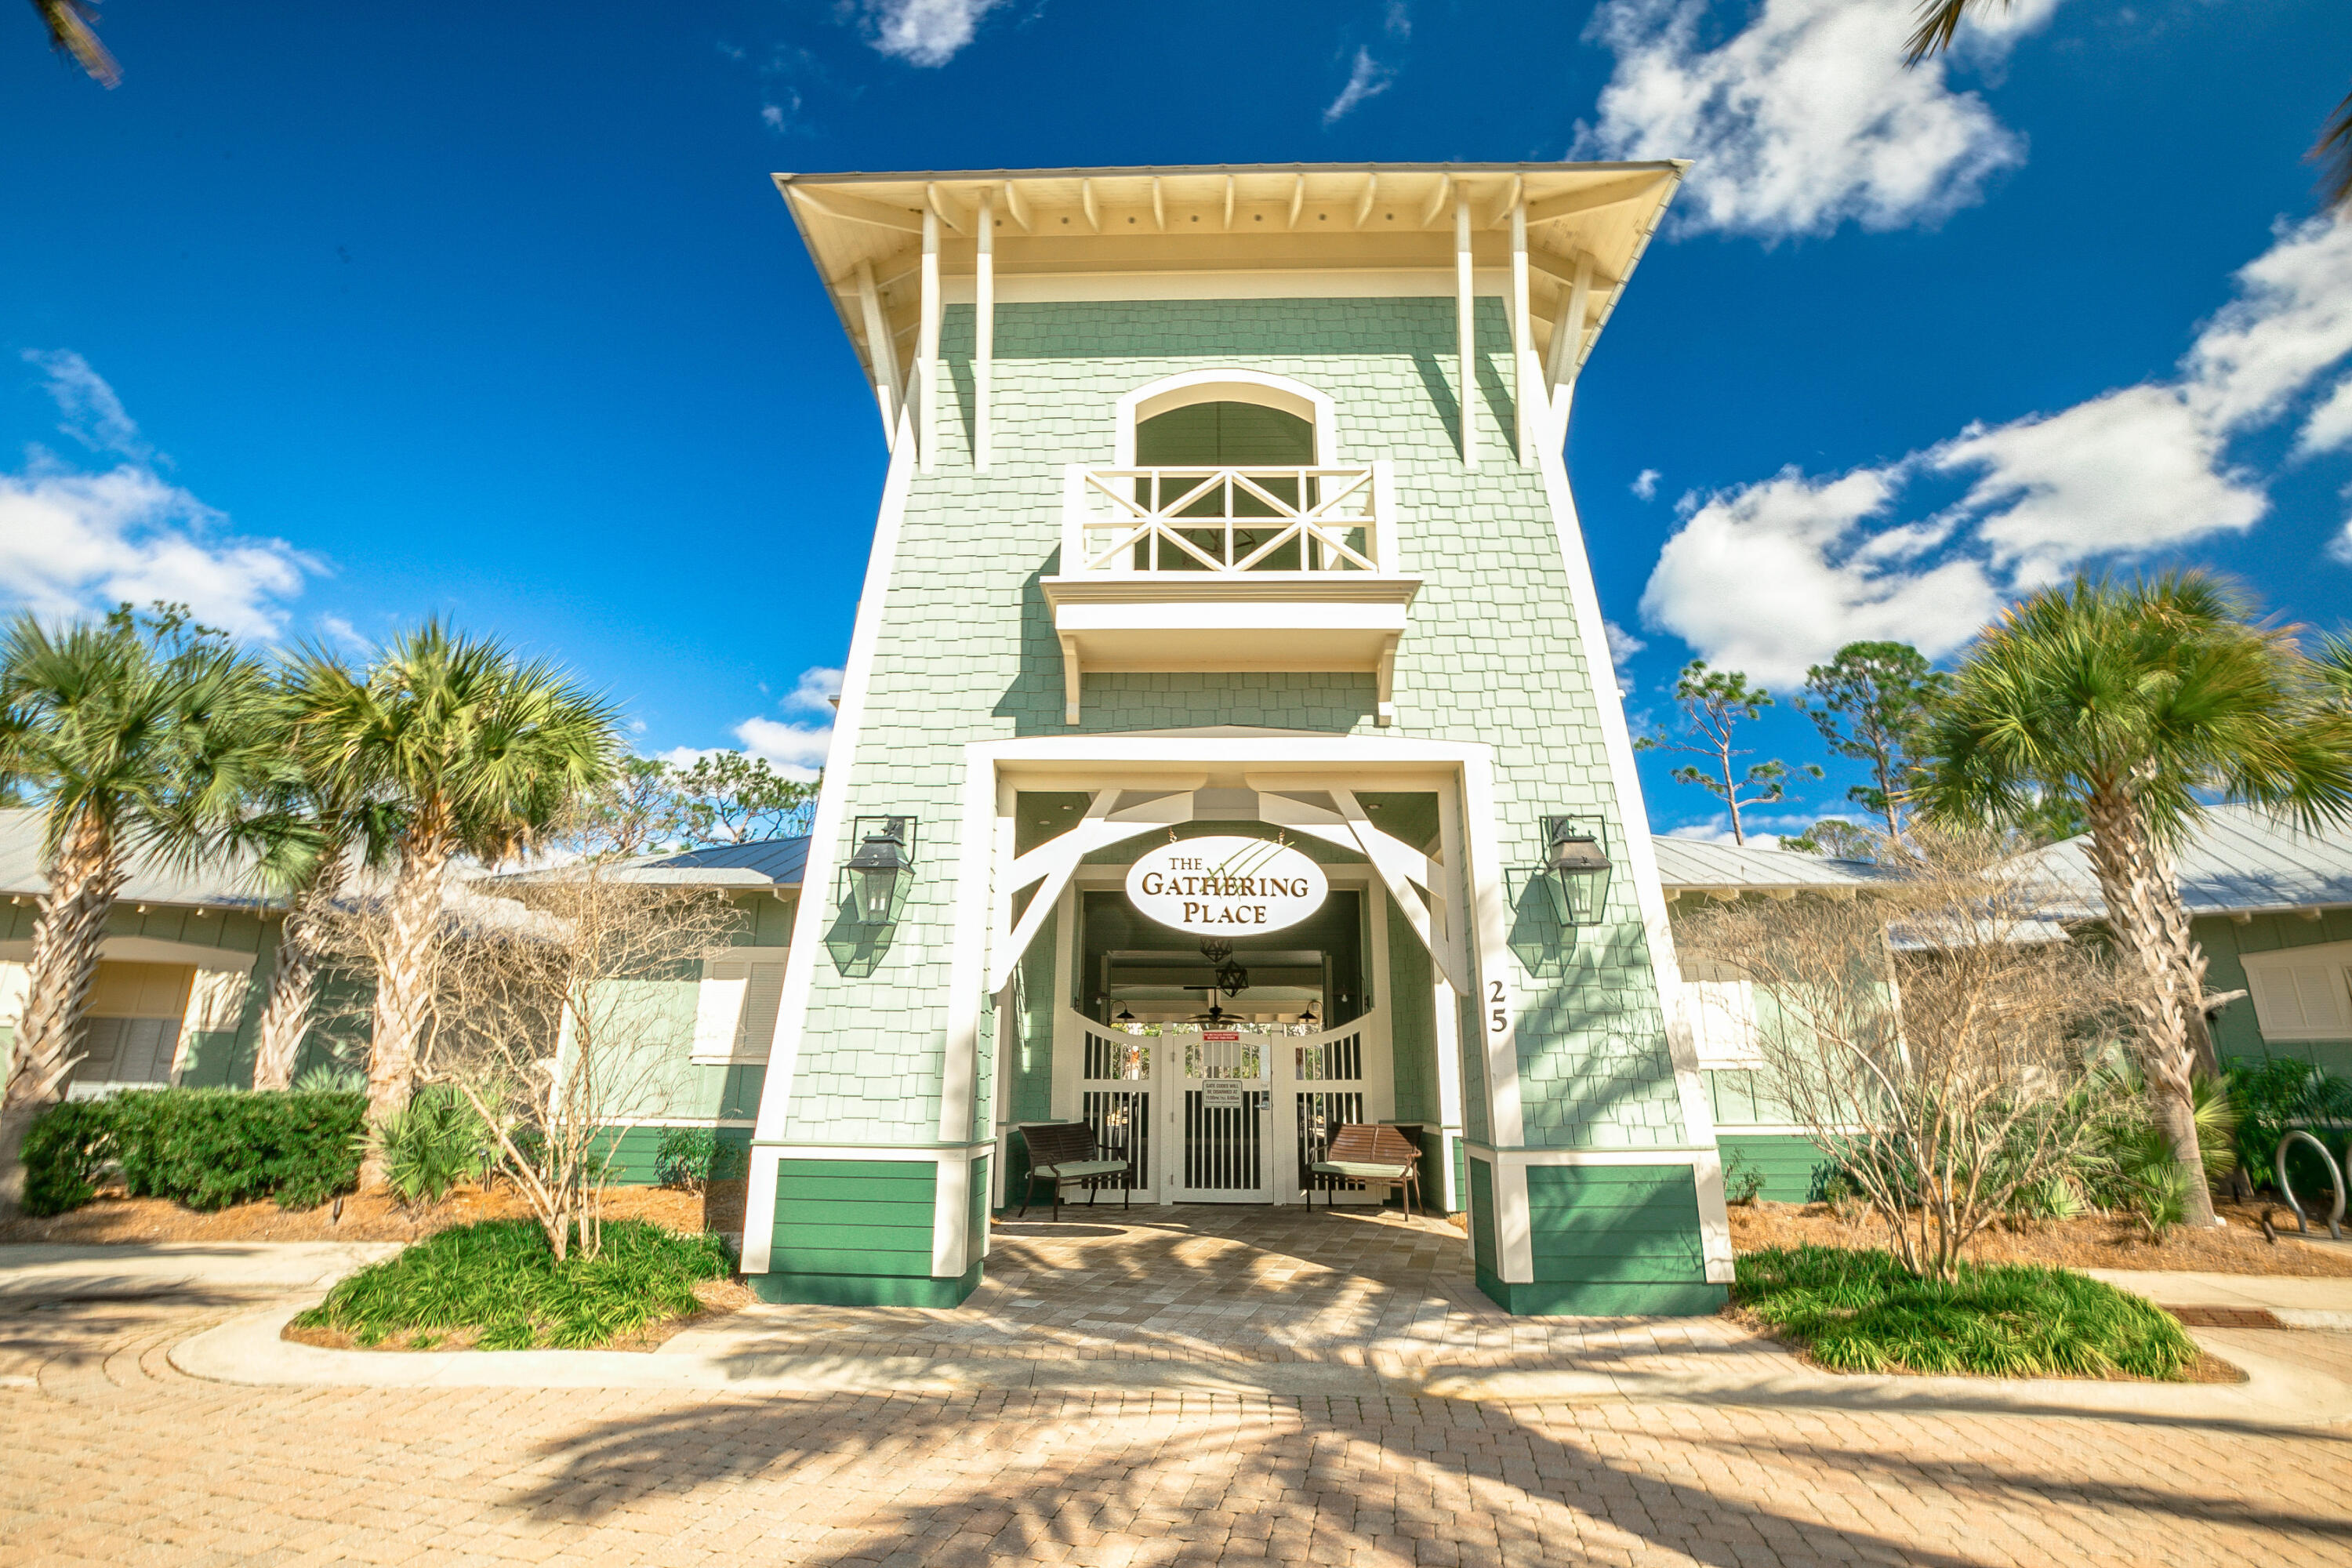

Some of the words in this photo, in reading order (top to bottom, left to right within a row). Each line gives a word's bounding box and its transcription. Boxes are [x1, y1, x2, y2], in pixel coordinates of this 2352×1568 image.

[1169, 858, 1203, 870] THE
[1142, 872, 1308, 898] GATHERING
[1183, 902, 1267, 924] PLACE
